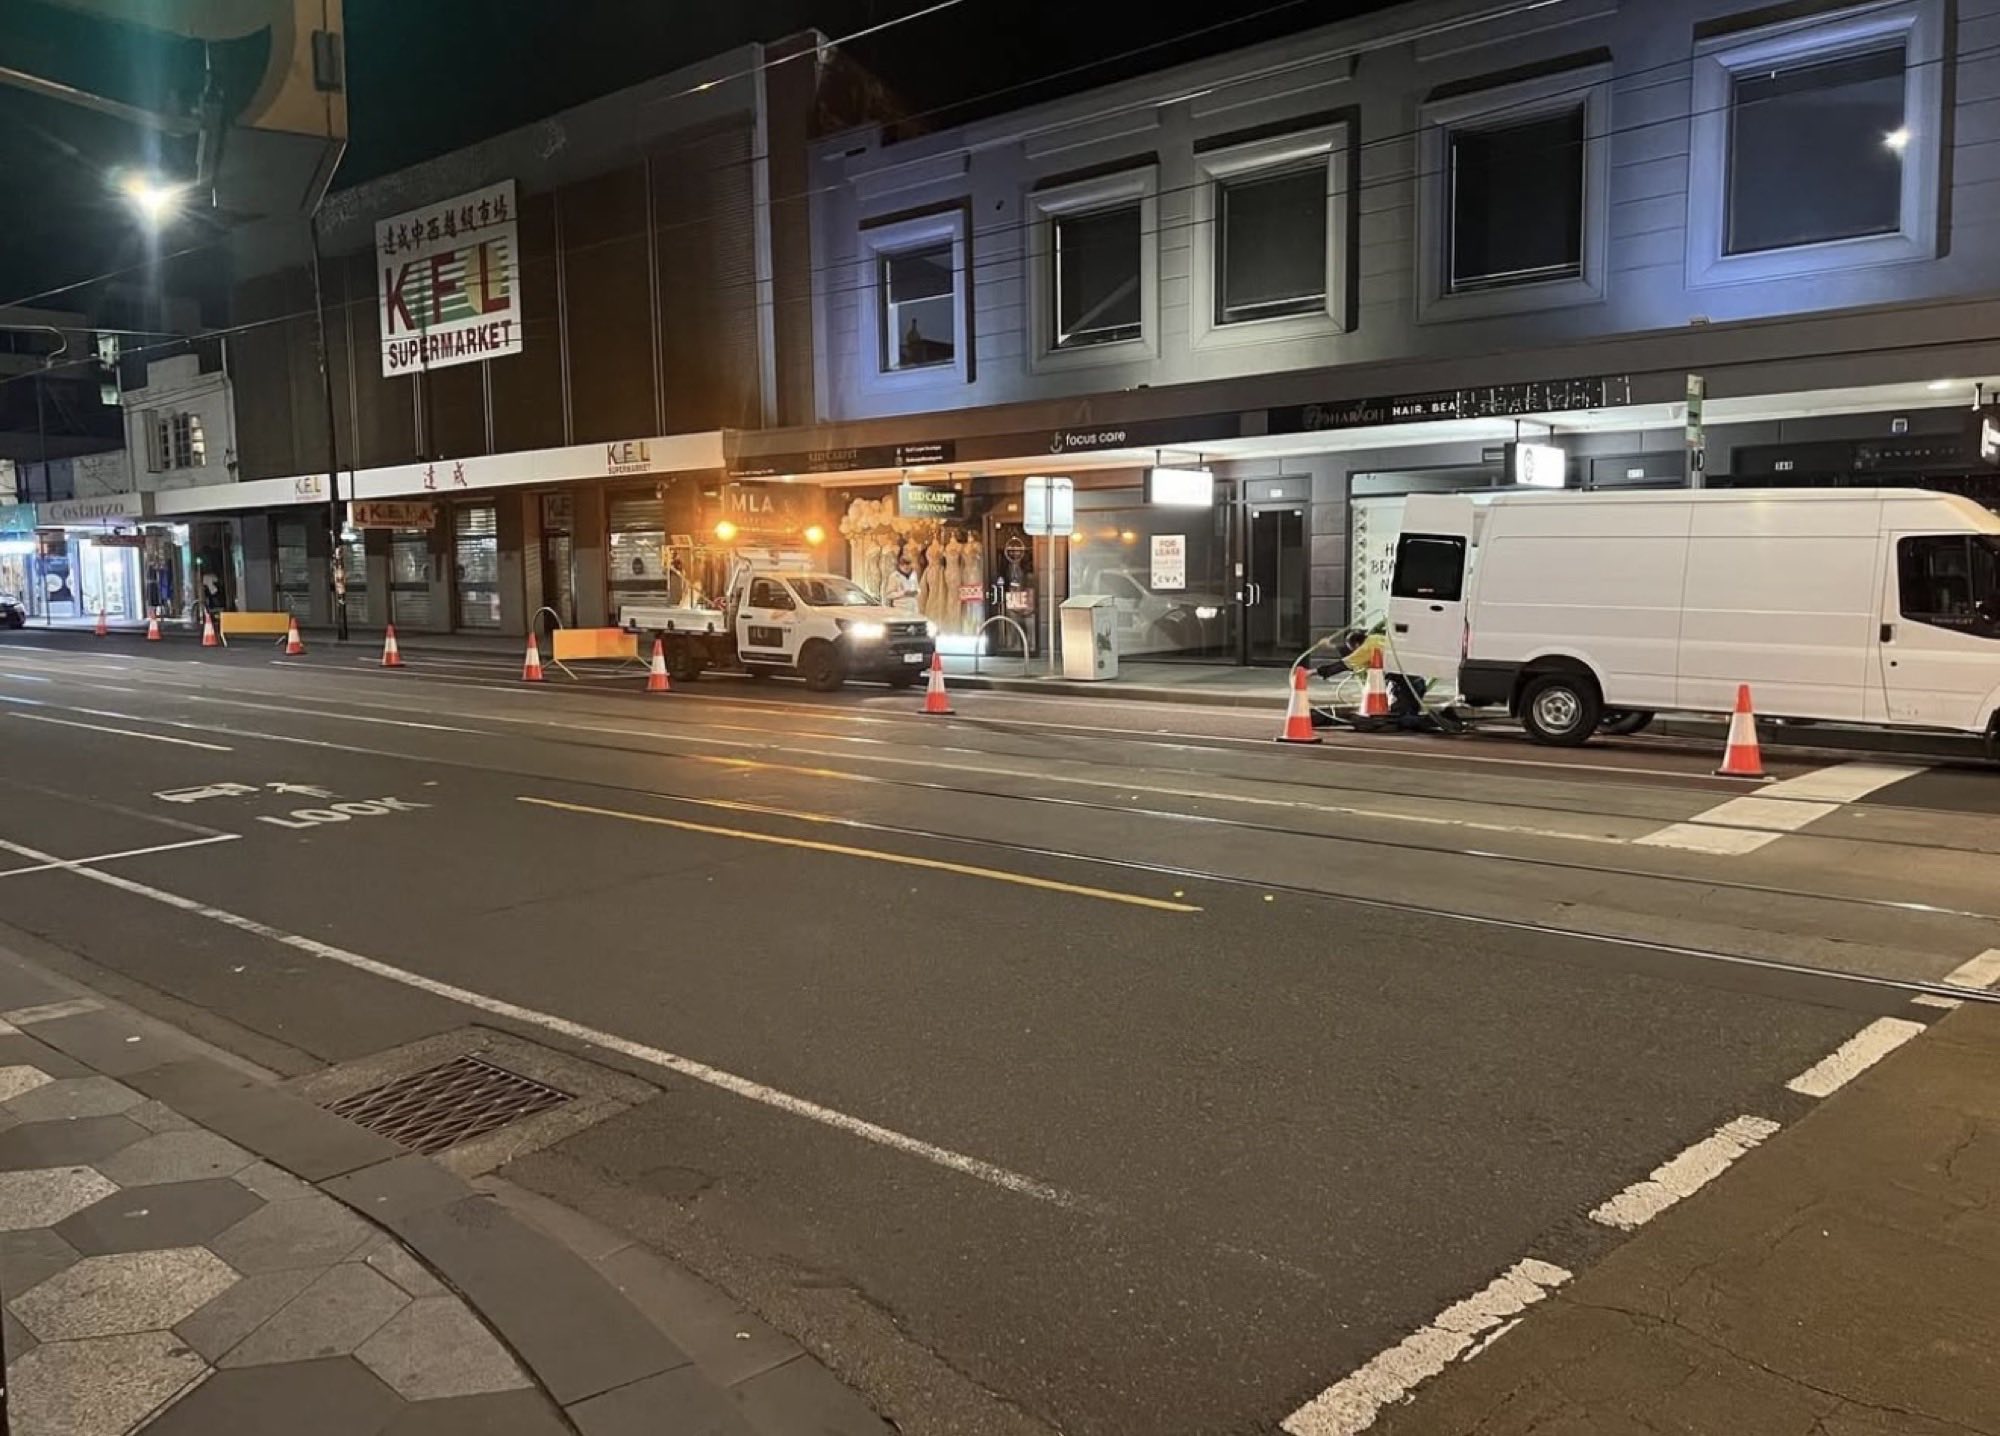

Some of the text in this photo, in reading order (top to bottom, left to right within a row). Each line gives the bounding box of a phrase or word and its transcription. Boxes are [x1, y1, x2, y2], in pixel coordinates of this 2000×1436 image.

[389, 319, 512, 369] SUPERMARKET
[1391, 403, 1427, 416] HAIR.
[1065, 429, 1127, 447] focus care
[50, 502, 124, 521] Costanzo
[1154, 547, 1180, 557] LEASE
[1159, 540, 1177, 548] FOR
[256, 797, 433, 828] LOOK
